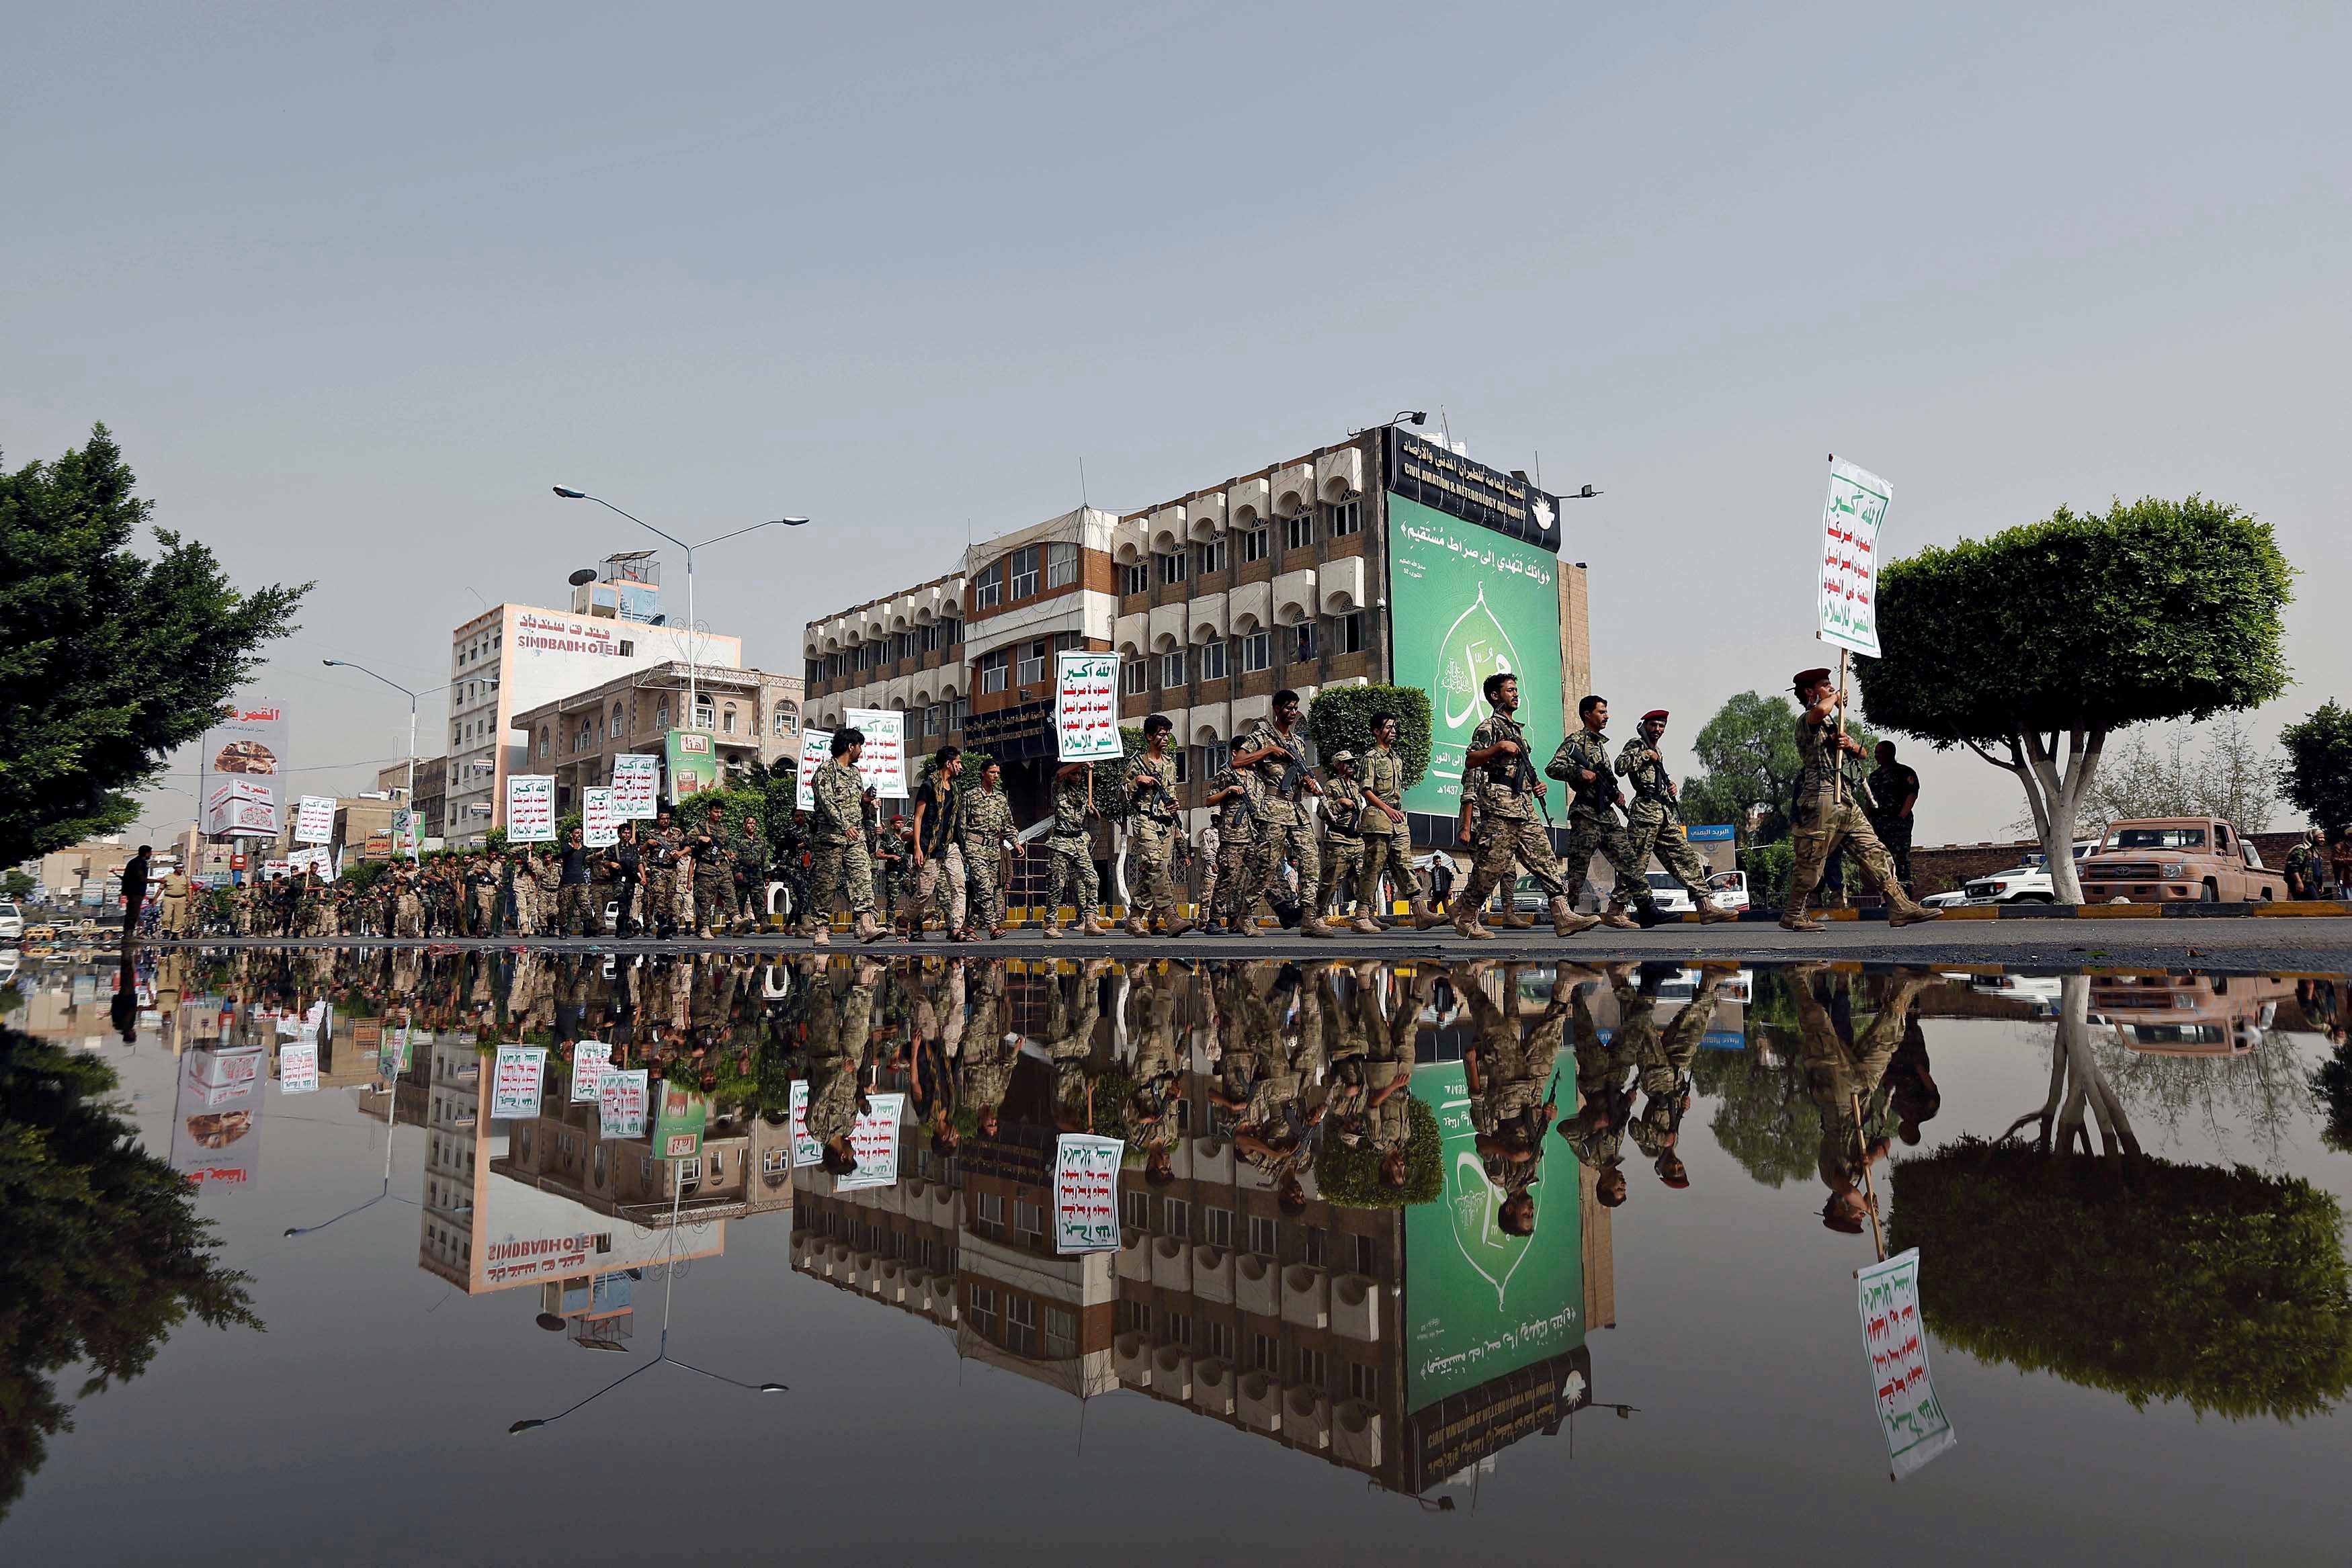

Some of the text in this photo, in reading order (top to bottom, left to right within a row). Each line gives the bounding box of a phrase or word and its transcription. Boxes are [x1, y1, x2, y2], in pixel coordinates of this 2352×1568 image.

[1404, 463, 1526, 520] CIVIL AVIATION & METEOROLOGY AUTHORITY
[1063, 658, 1114, 683] الله أكبر
[1093, 684, 1111, 697] الموت
[1093, 701, 1111, 713] الموت
[882, 720, 898, 733] الله
[1063, 717, 1111, 732] اللعنة على اليهود
[806, 738, 829, 752] أكبر
[1064, 734, 1091, 752] للإسلام
[1095, 732, 1115, 750] النصر
[513, 781, 549, 795] الله أكبر
